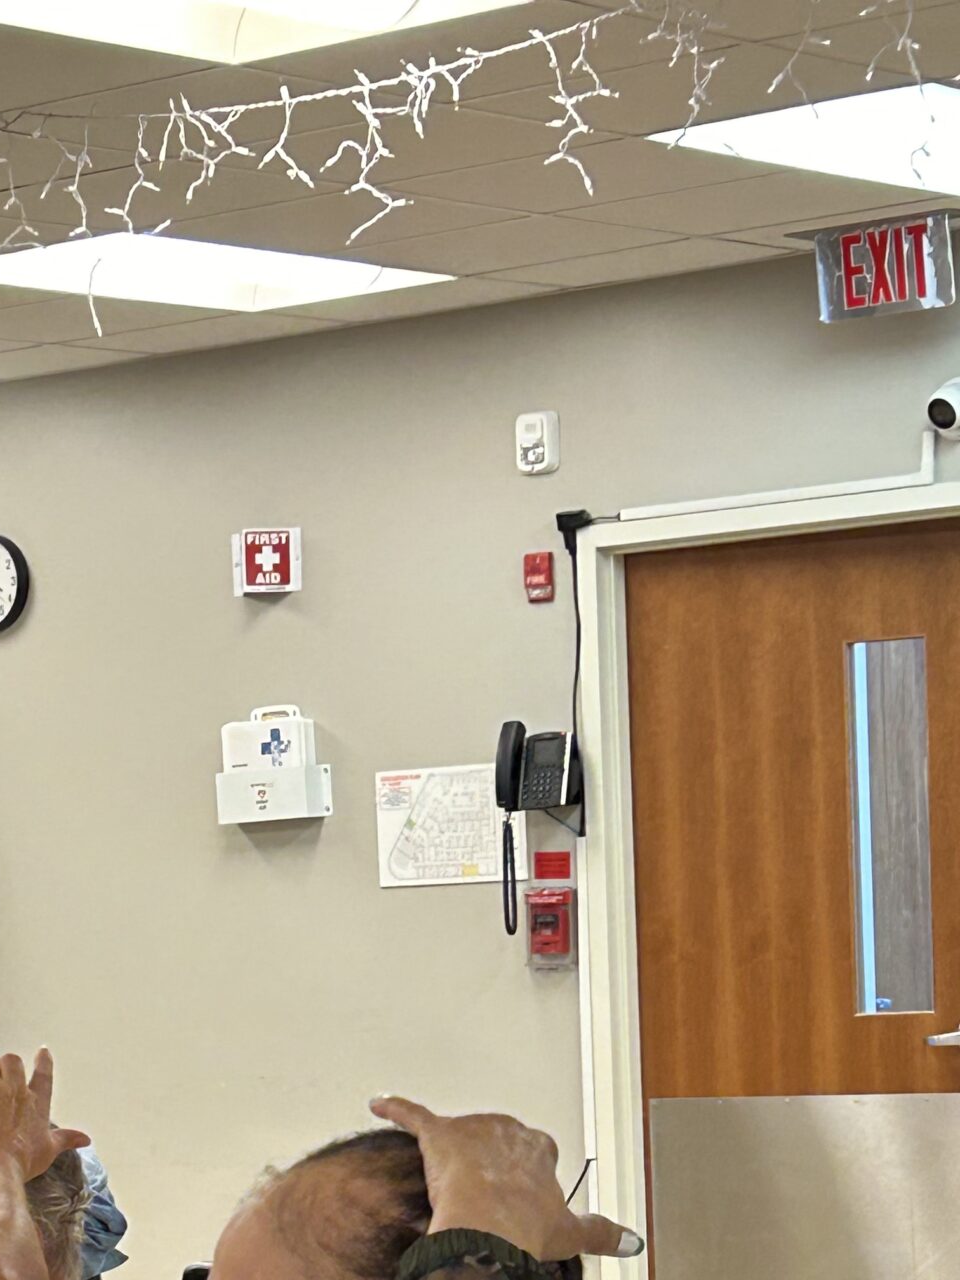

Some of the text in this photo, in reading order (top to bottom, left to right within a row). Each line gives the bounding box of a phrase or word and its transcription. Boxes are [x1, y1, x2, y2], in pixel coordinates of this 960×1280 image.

[840, 223, 928, 310] EXIT
[247, 533, 288, 545] FIRST
[256, 573, 280, 584] AID
